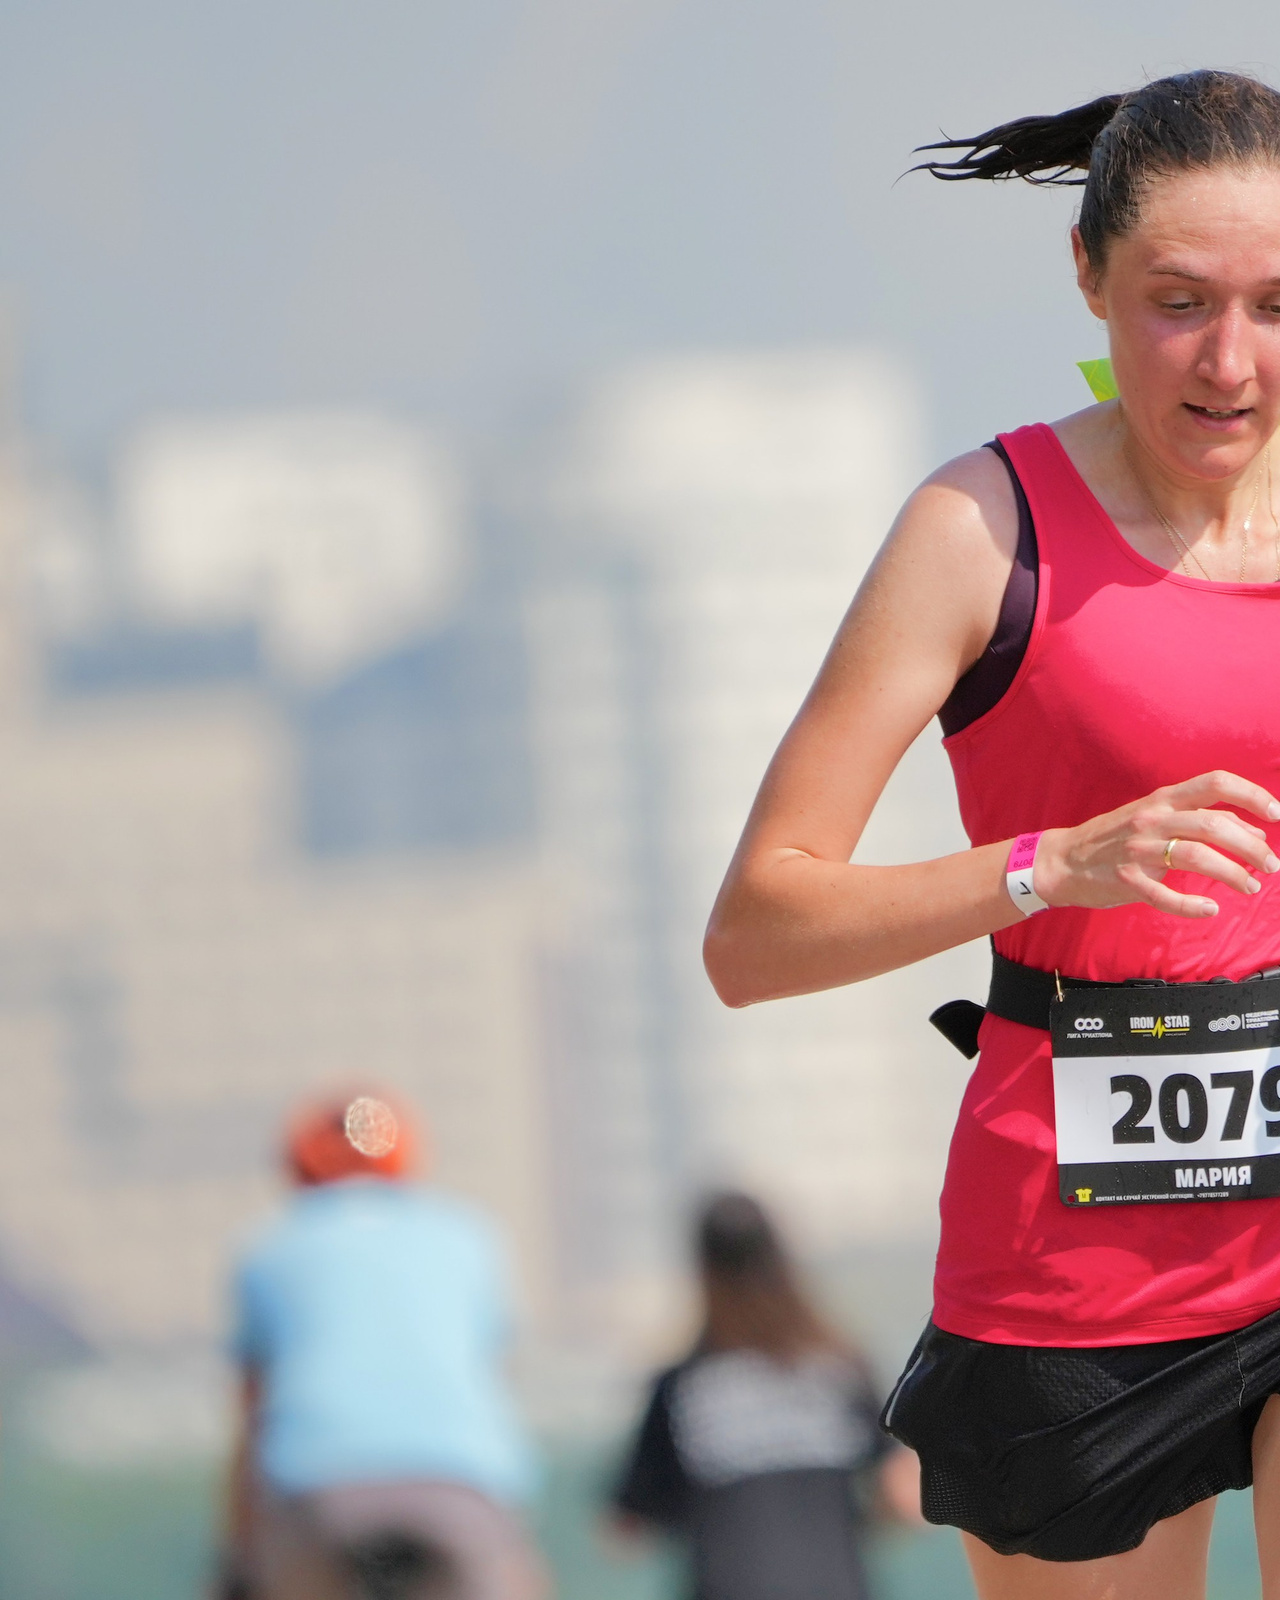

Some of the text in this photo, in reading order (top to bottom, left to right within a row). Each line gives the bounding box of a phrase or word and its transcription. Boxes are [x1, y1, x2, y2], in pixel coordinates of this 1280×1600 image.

[1130, 1015, 1190, 1029] IRON STAR
[1175, 1165, 1252, 1188] МАРИЯ
